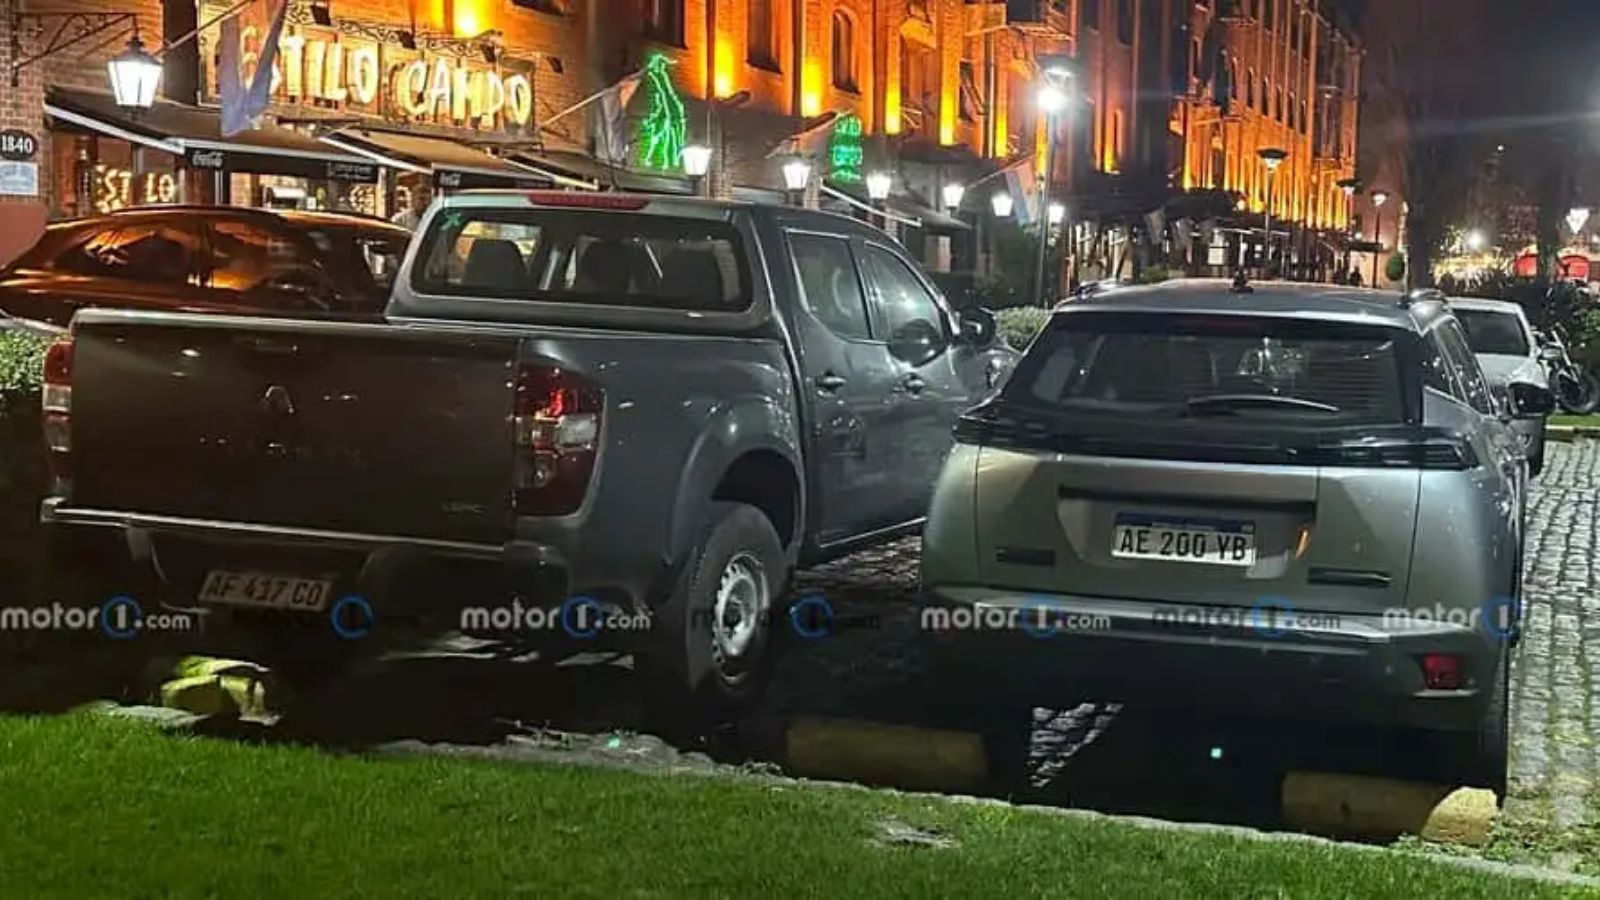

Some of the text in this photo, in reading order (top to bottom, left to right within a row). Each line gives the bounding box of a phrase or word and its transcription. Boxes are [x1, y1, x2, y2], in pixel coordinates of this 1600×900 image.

[396, 57, 532, 127] CAMPO
[2, 134, 33, 155] 1840
[1120, 528, 1247, 561] AE 200 YB
[205, 574, 241, 597] AF
